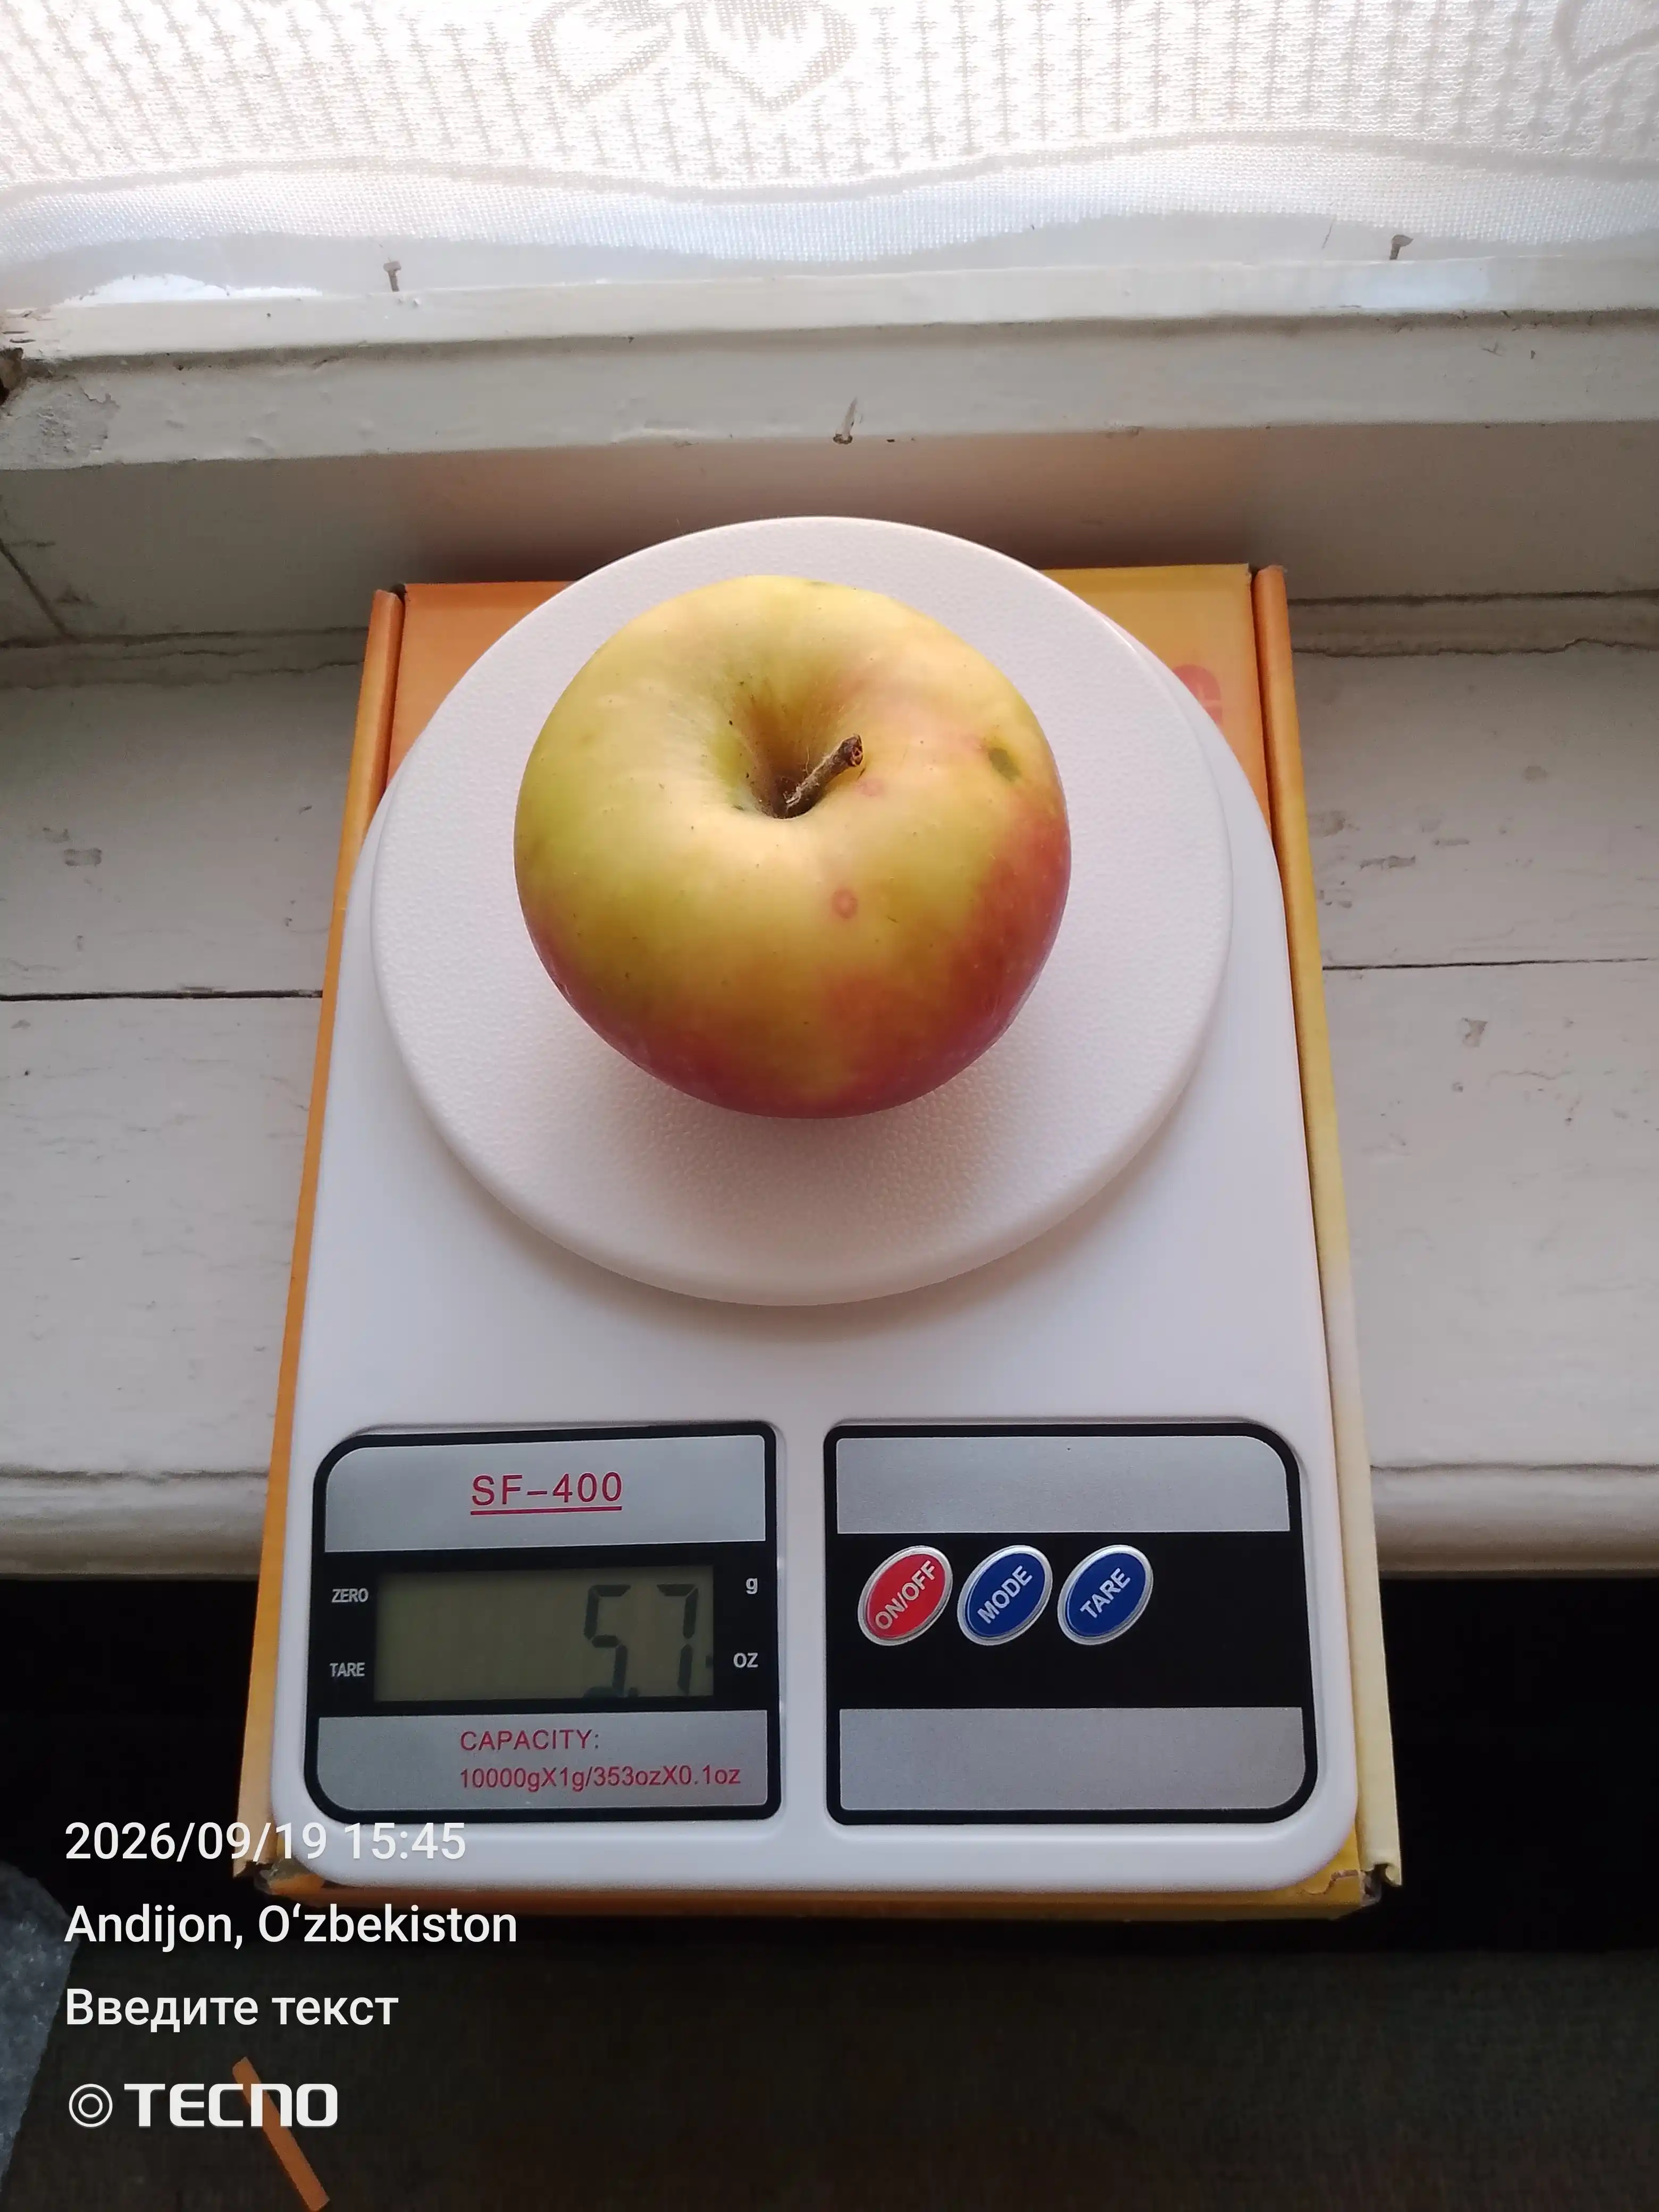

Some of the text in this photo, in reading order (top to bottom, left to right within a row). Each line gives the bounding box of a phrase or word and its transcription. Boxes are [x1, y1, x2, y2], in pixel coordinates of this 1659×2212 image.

[471, 1471, 622, 1506] SF-400
[331, 1587, 368, 1603] ZERO
[745, 1578, 759, 1595] g
[875, 1560, 937, 1630] ON/OFF
[977, 1565, 1033, 1624] MODE
[1080, 1568, 1131, 1621] TARE
[583, 1583, 699, 1698] 5.7
[330, 1662, 365, 1678] TARE
[460, 1729, 599, 1752] CAPACITY:
[460, 1765, 741, 1792] 10000gX1g/353ozX0.1oz
